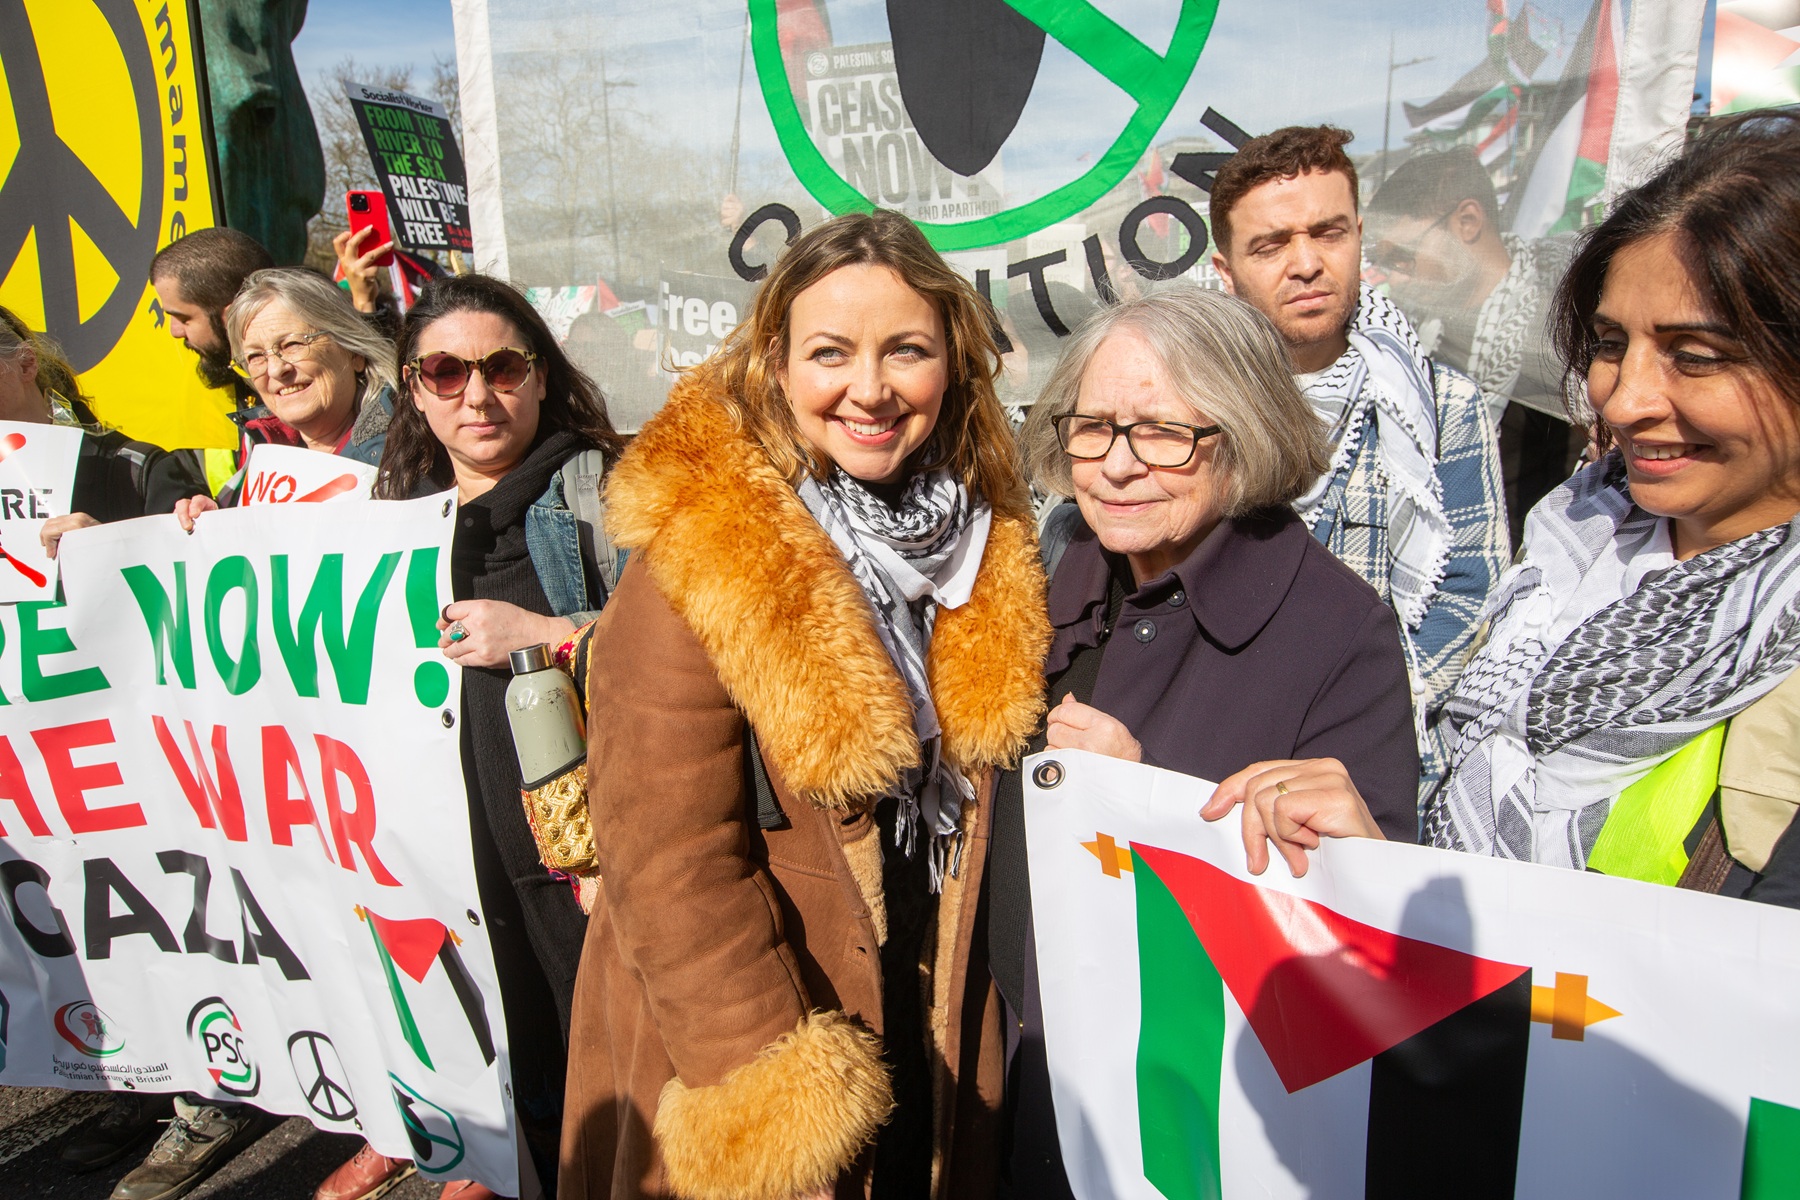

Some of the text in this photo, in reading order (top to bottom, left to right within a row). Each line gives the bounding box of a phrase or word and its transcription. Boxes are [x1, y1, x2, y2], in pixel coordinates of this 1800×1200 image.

[833, 52, 880, 69] PALESTINE
[363, 104, 445, 140] FROM THE
[817, 77, 914, 136] CEAS
[371, 128, 444, 160] RIVER TO
[149, 0, 189, 330] mamet
[379, 151, 447, 181] THE SEA
[388, 174, 469, 206] PALESTINE
[396, 198, 461, 226] WILL BE
[404, 221, 448, 245] FREE
[0, 546, 450, 708] E NOW!
[151, 714, 404, 887] WAR
[0, 849, 312, 981] GAZA
[202, 1032, 251, 1069] PSC
[135, 1073, 172, 1084] Britain
